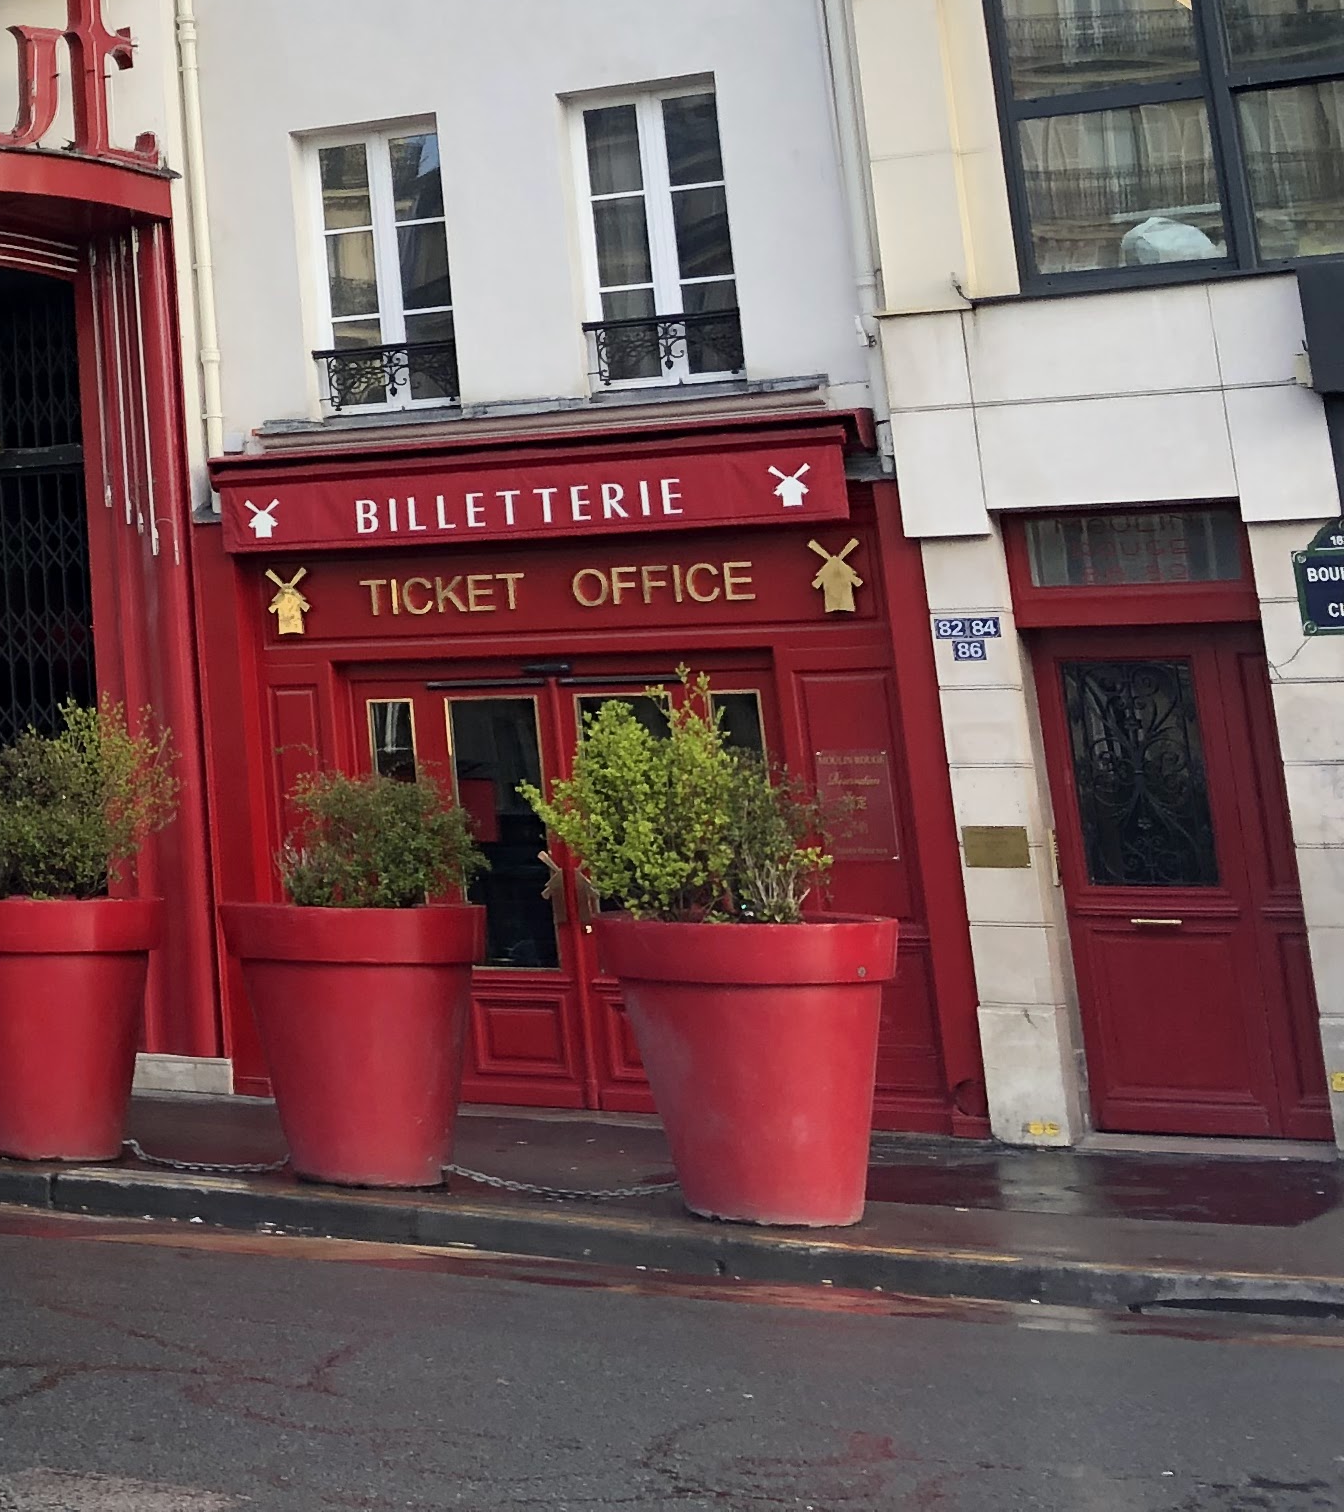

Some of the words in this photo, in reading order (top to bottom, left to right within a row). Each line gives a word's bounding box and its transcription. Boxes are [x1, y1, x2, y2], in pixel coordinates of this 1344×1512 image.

[355, 478, 684, 534] BILLETTERIE
[1330, 535, 1344, 545] 18
[359, 572, 525, 617] TICKET
[571, 560, 756, 608] OFFICE
[938, 621, 964, 636] 82
[971, 619, 996, 635] 84
[957, 642, 982, 658] 86
